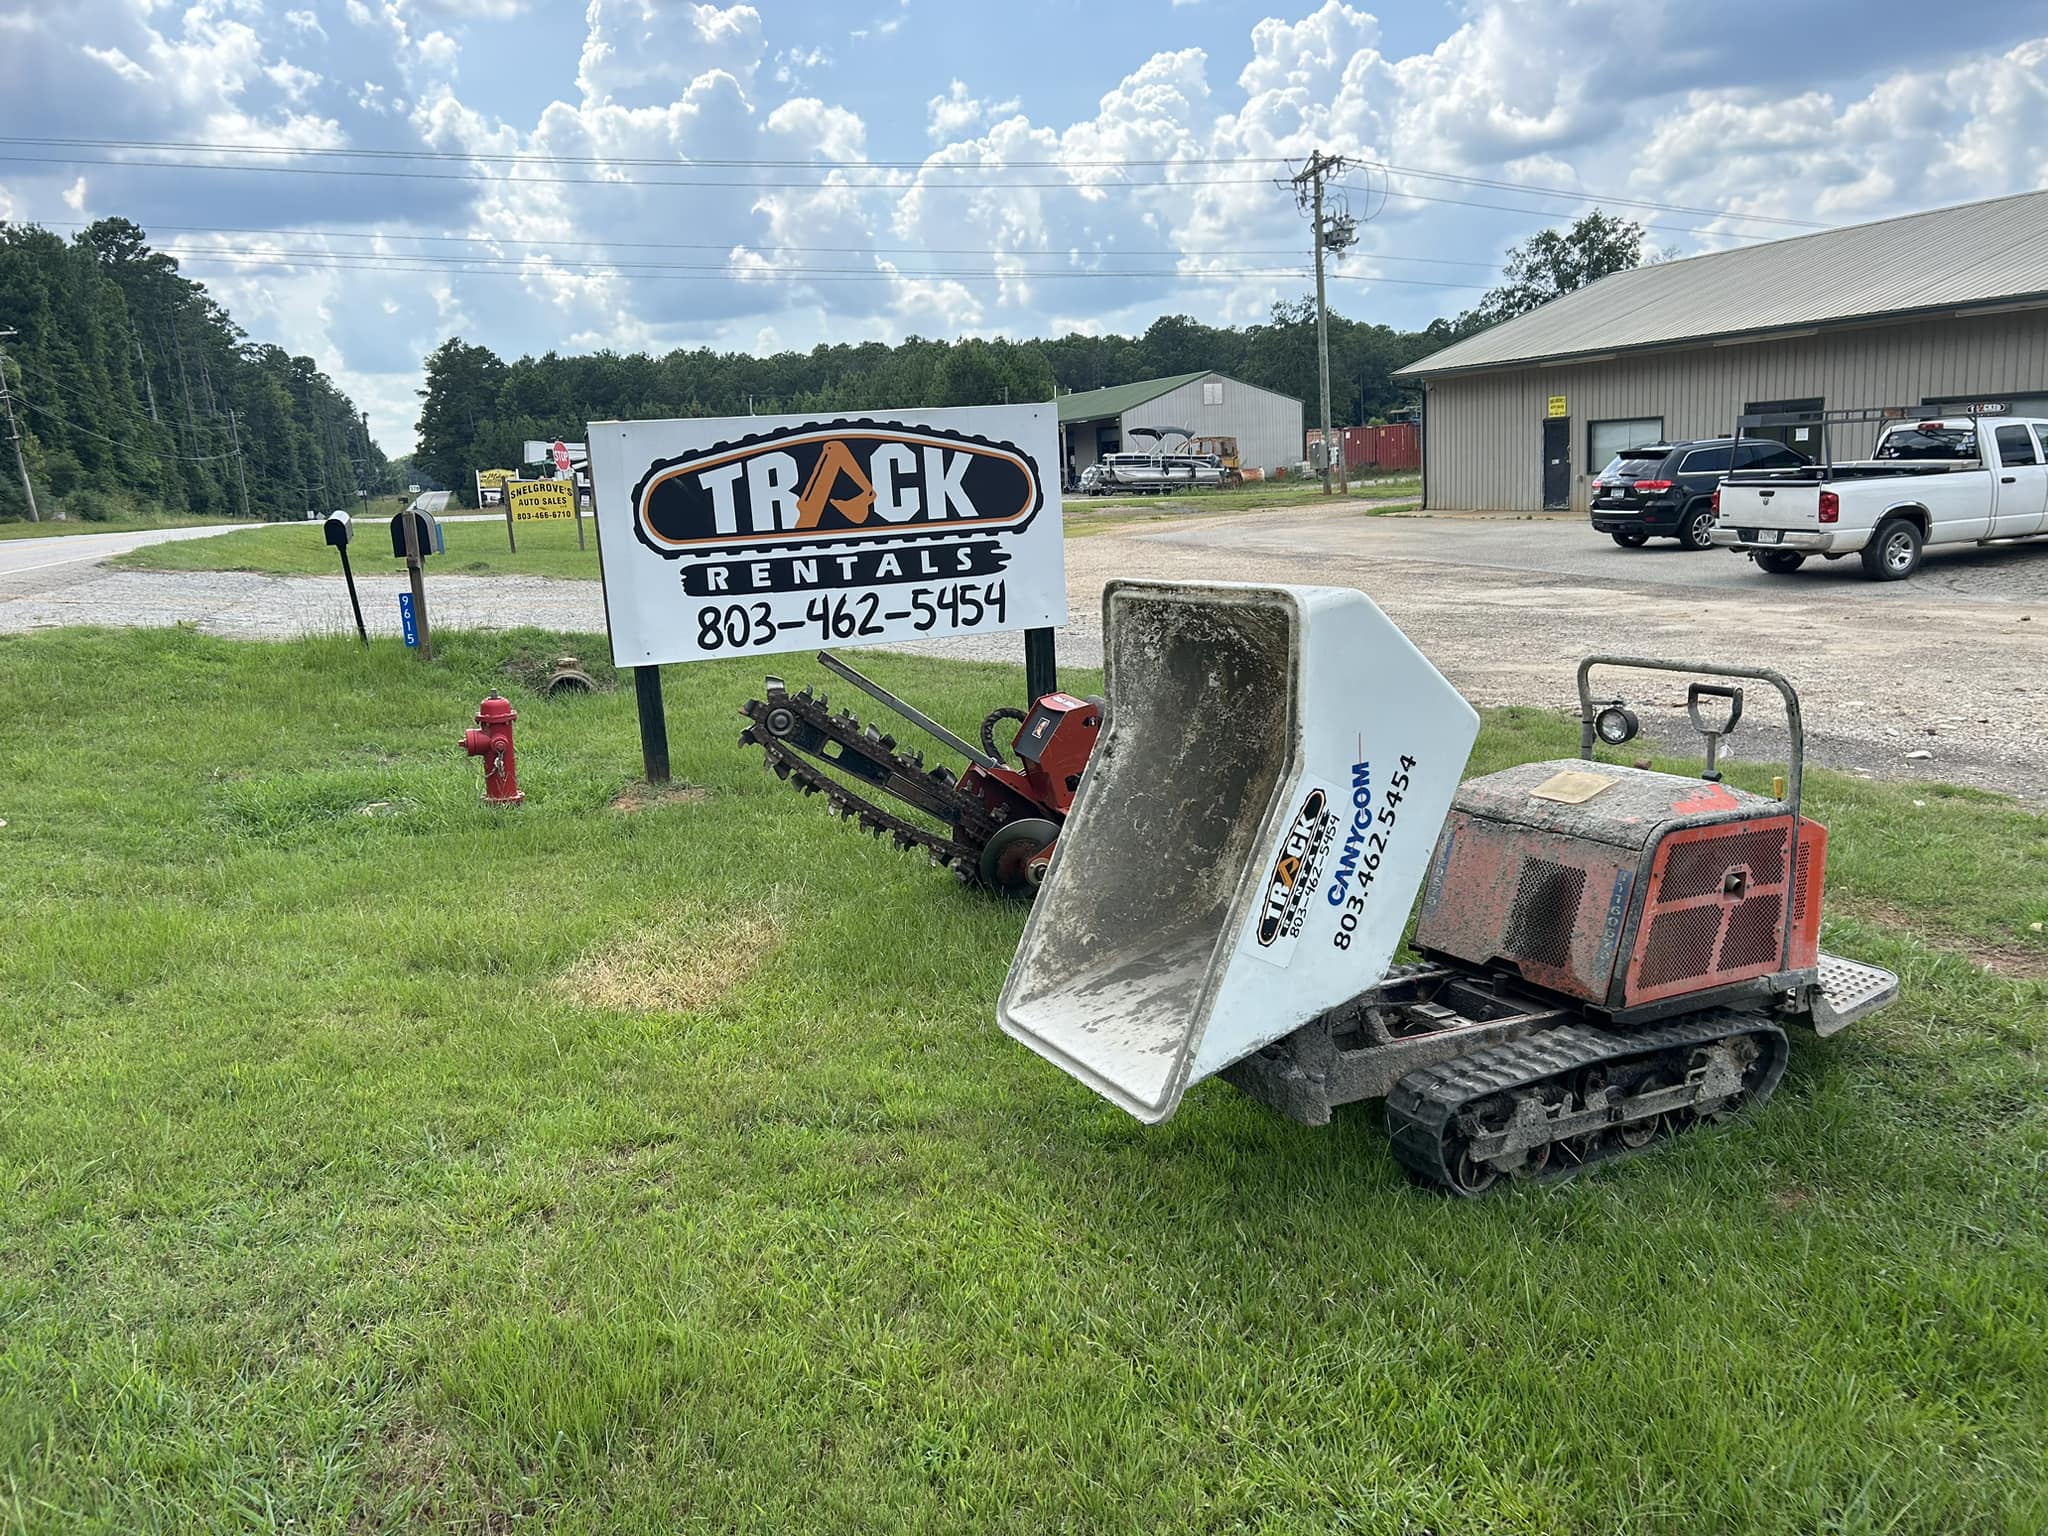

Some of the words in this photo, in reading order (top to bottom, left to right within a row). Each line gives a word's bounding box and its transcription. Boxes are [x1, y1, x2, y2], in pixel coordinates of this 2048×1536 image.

[510, 482, 573, 499] SNELGROVE'S
[554, 450, 569, 462] STOP
[698, 440, 979, 534] TRACK
[518, 498, 540, 506] AUTO
[542, 497, 567, 505] SALES
[707, 547, 973, 591] RENTALS
[401, 595, 415, 644] 9615
[697, 579, 1006, 650] 803-462-5454
[1266, 812, 1316, 920] TRACK
[1327, 761, 1372, 907] CANYCOM
[1334, 754, 1417, 951] 803.462.5454
[1290, 814, 1341, 938] 803-462-5454
